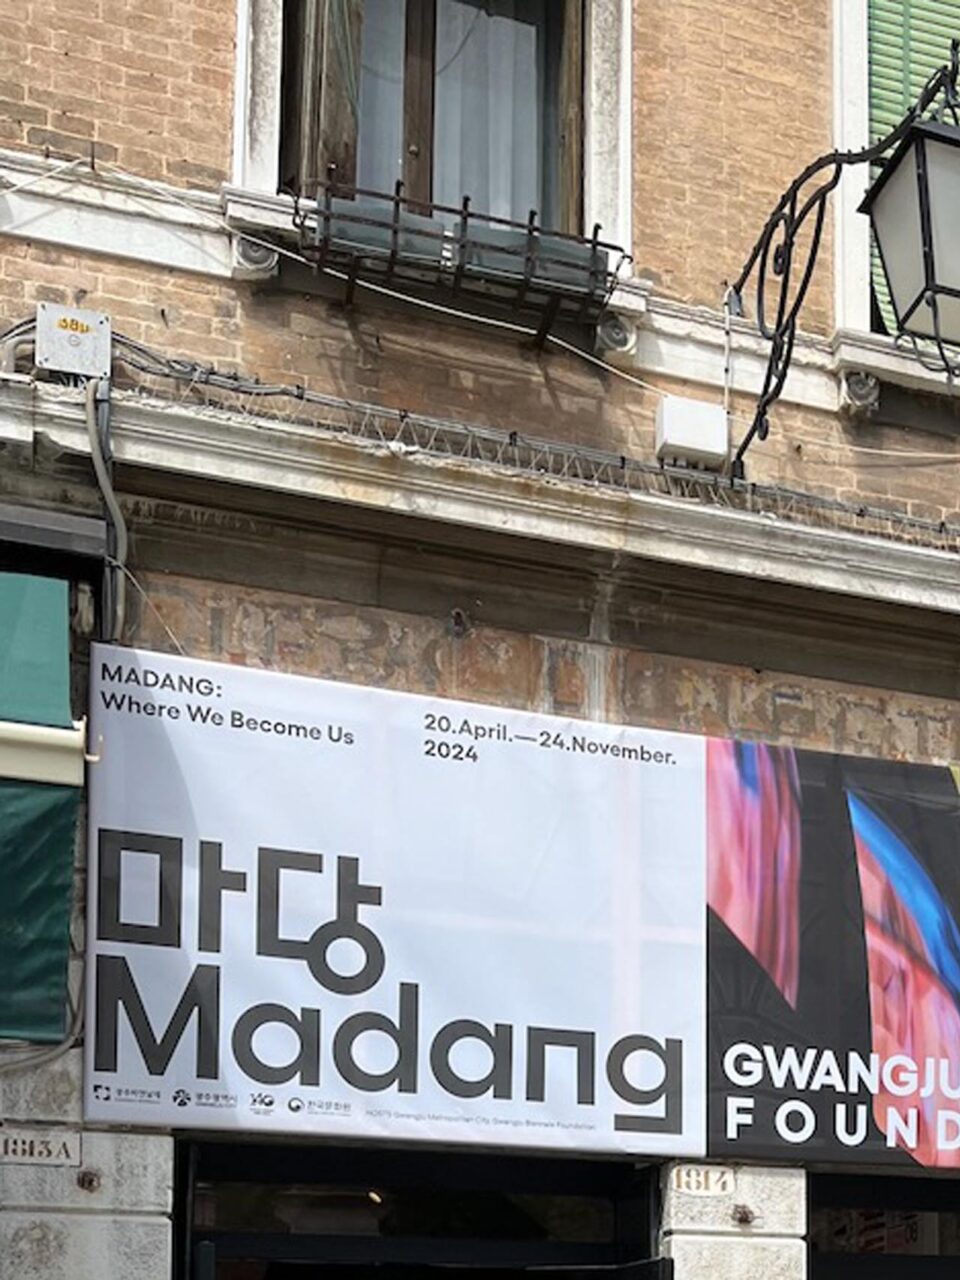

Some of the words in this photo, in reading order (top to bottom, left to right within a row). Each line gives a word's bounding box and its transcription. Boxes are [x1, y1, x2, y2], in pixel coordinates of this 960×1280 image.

[101, 663, 222, 697] MADANG:
[100, 690, 180, 719] Where
[186, 704, 223, 726] We
[230, 710, 321, 740] Become
[328, 725, 354, 745] Us
[424, 739, 478, 763] 2024
[95, 827, 386, 996] 마당
[94, 953, 684, 1135] Madang
